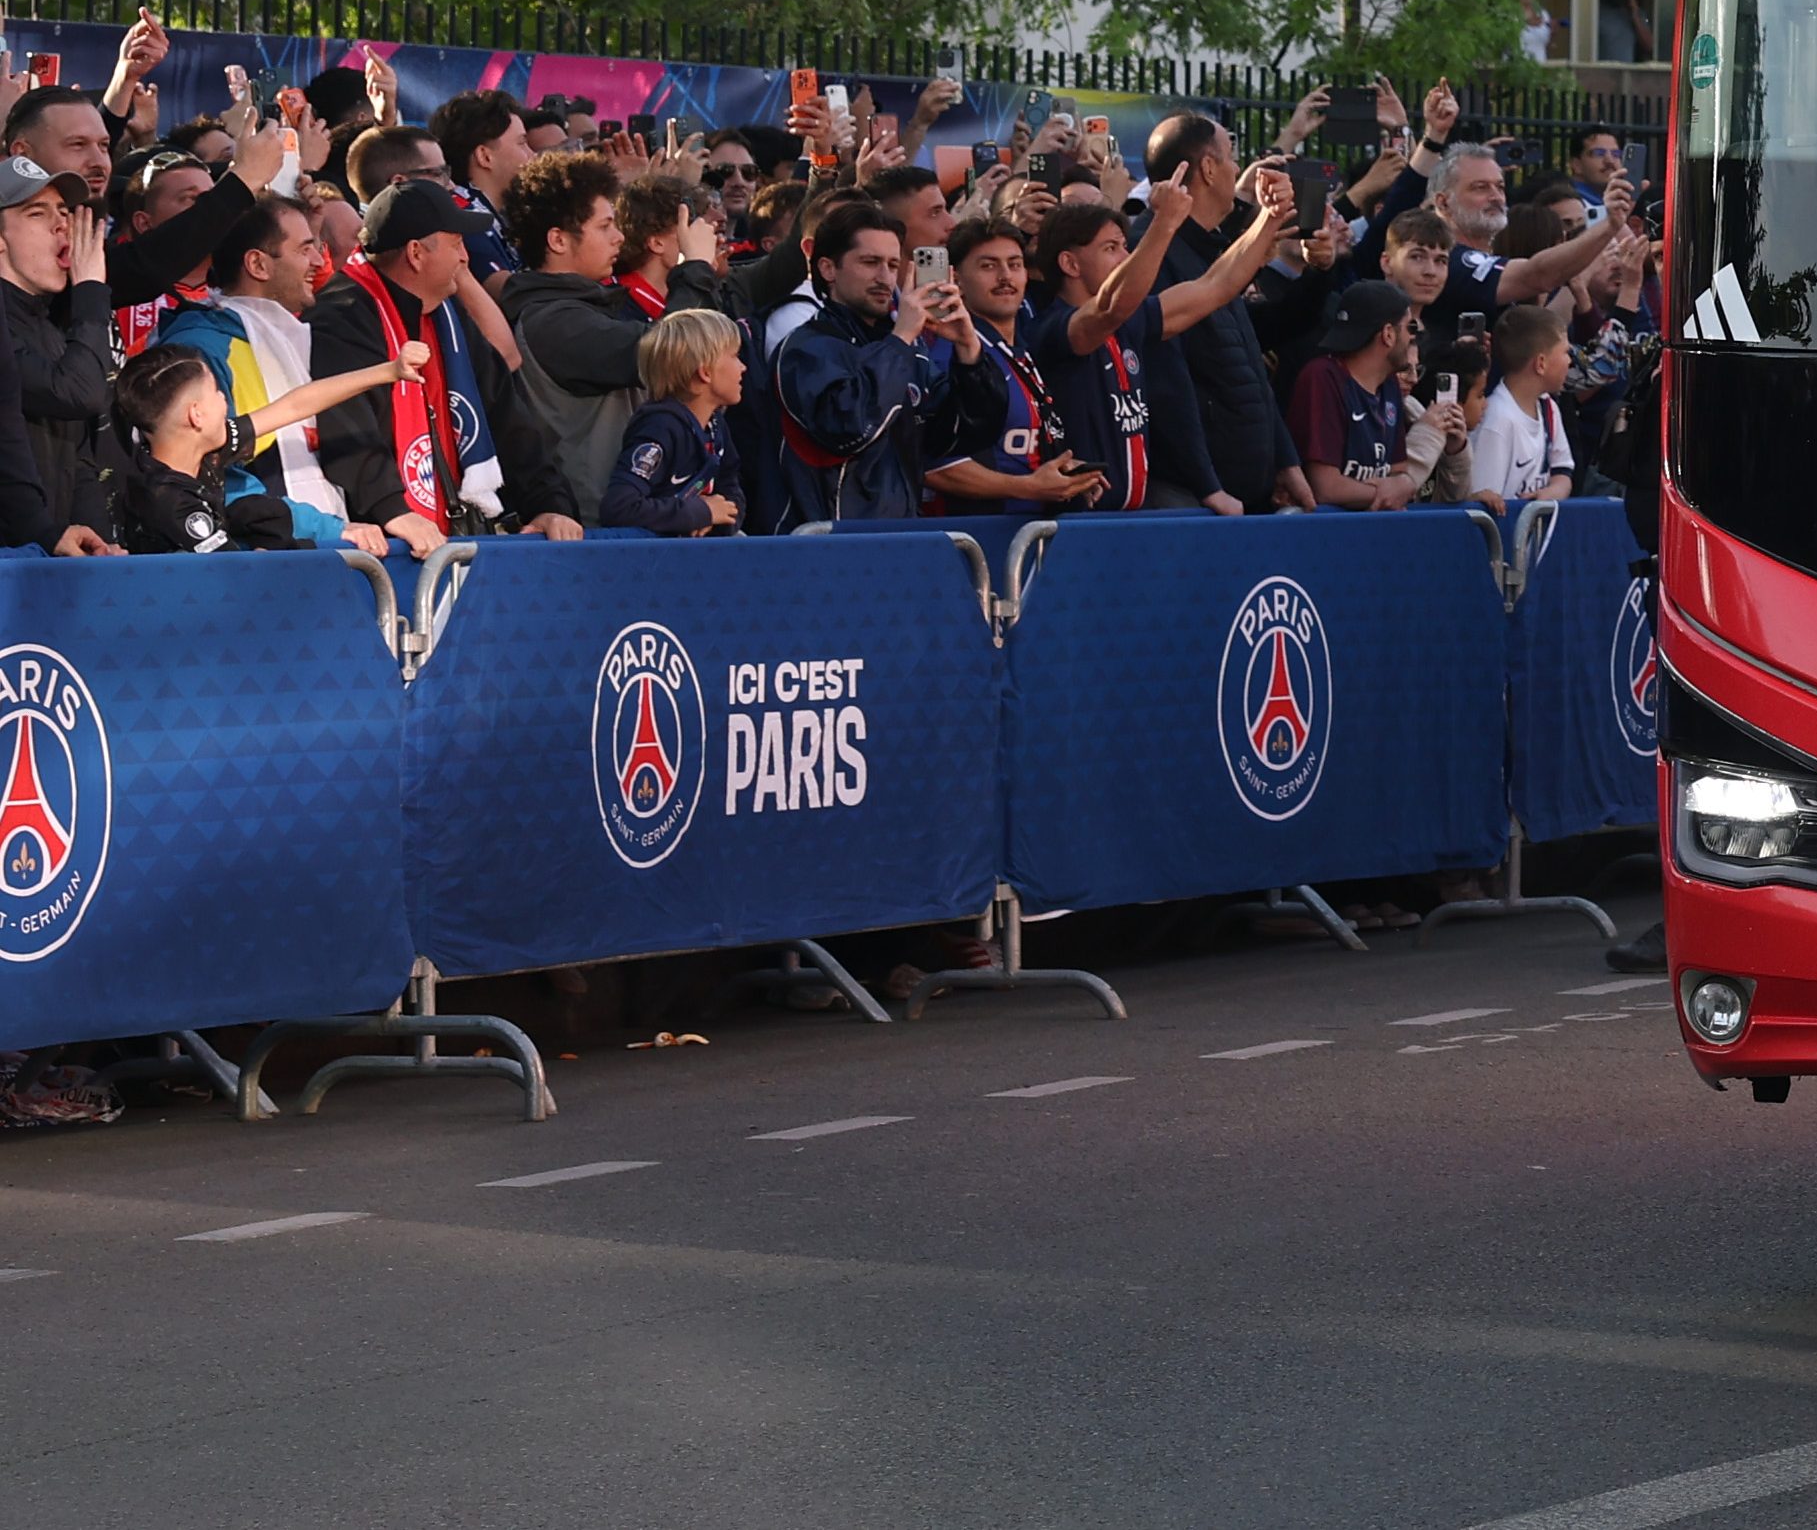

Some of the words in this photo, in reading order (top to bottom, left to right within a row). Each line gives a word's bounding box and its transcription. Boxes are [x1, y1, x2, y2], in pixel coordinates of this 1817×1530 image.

[1239, 587, 1318, 647] PARIS
[606, 632, 687, 690] PARIS
[728, 663, 766, 706] ICI
[774, 657, 864, 703] C'EST
[0, 659, 82, 732] ARIS
[724, 705, 868, 817] PARIS
